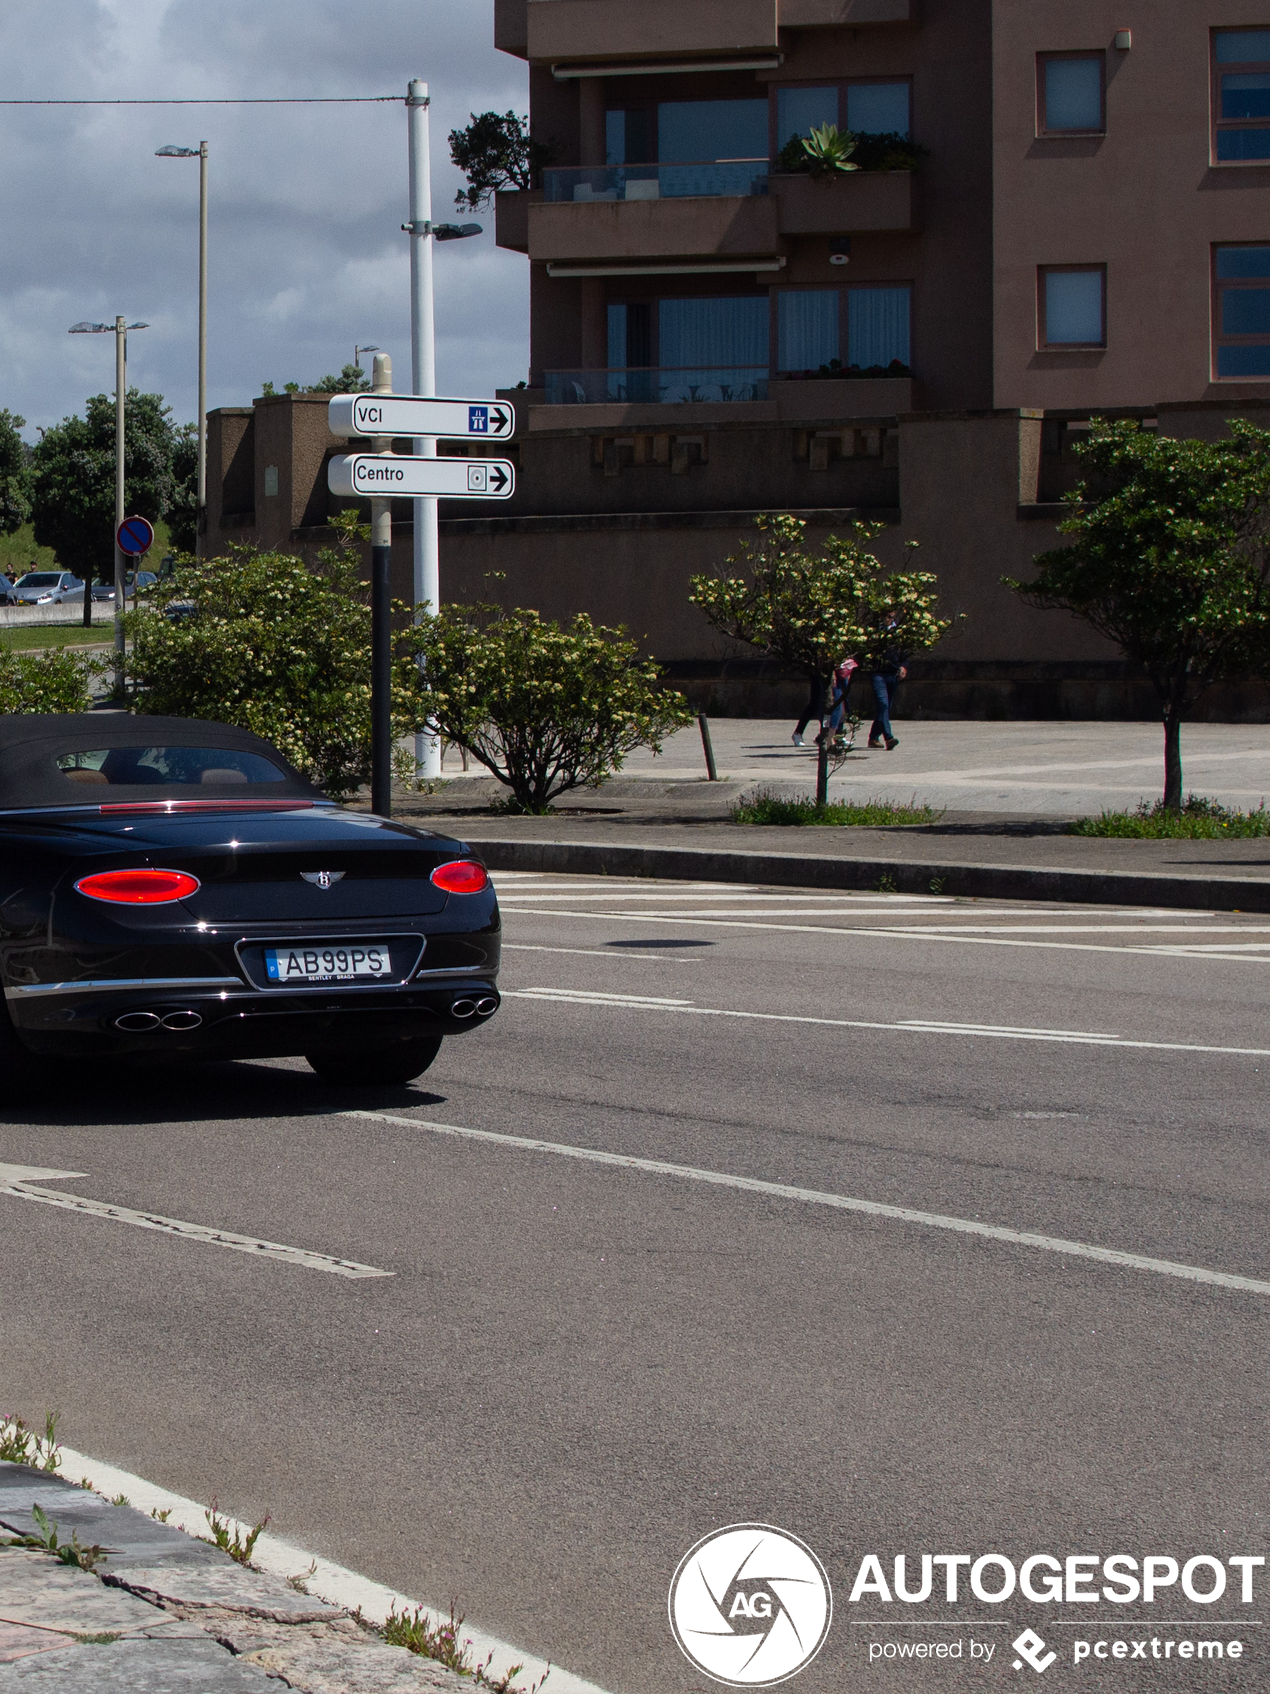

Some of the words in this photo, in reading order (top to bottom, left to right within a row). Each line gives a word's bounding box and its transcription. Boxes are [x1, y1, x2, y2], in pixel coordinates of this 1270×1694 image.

[358, 407, 382, 423] VCI
[357, 465, 404, 481] Centro
[286, 949, 382, 975] AB99PS
